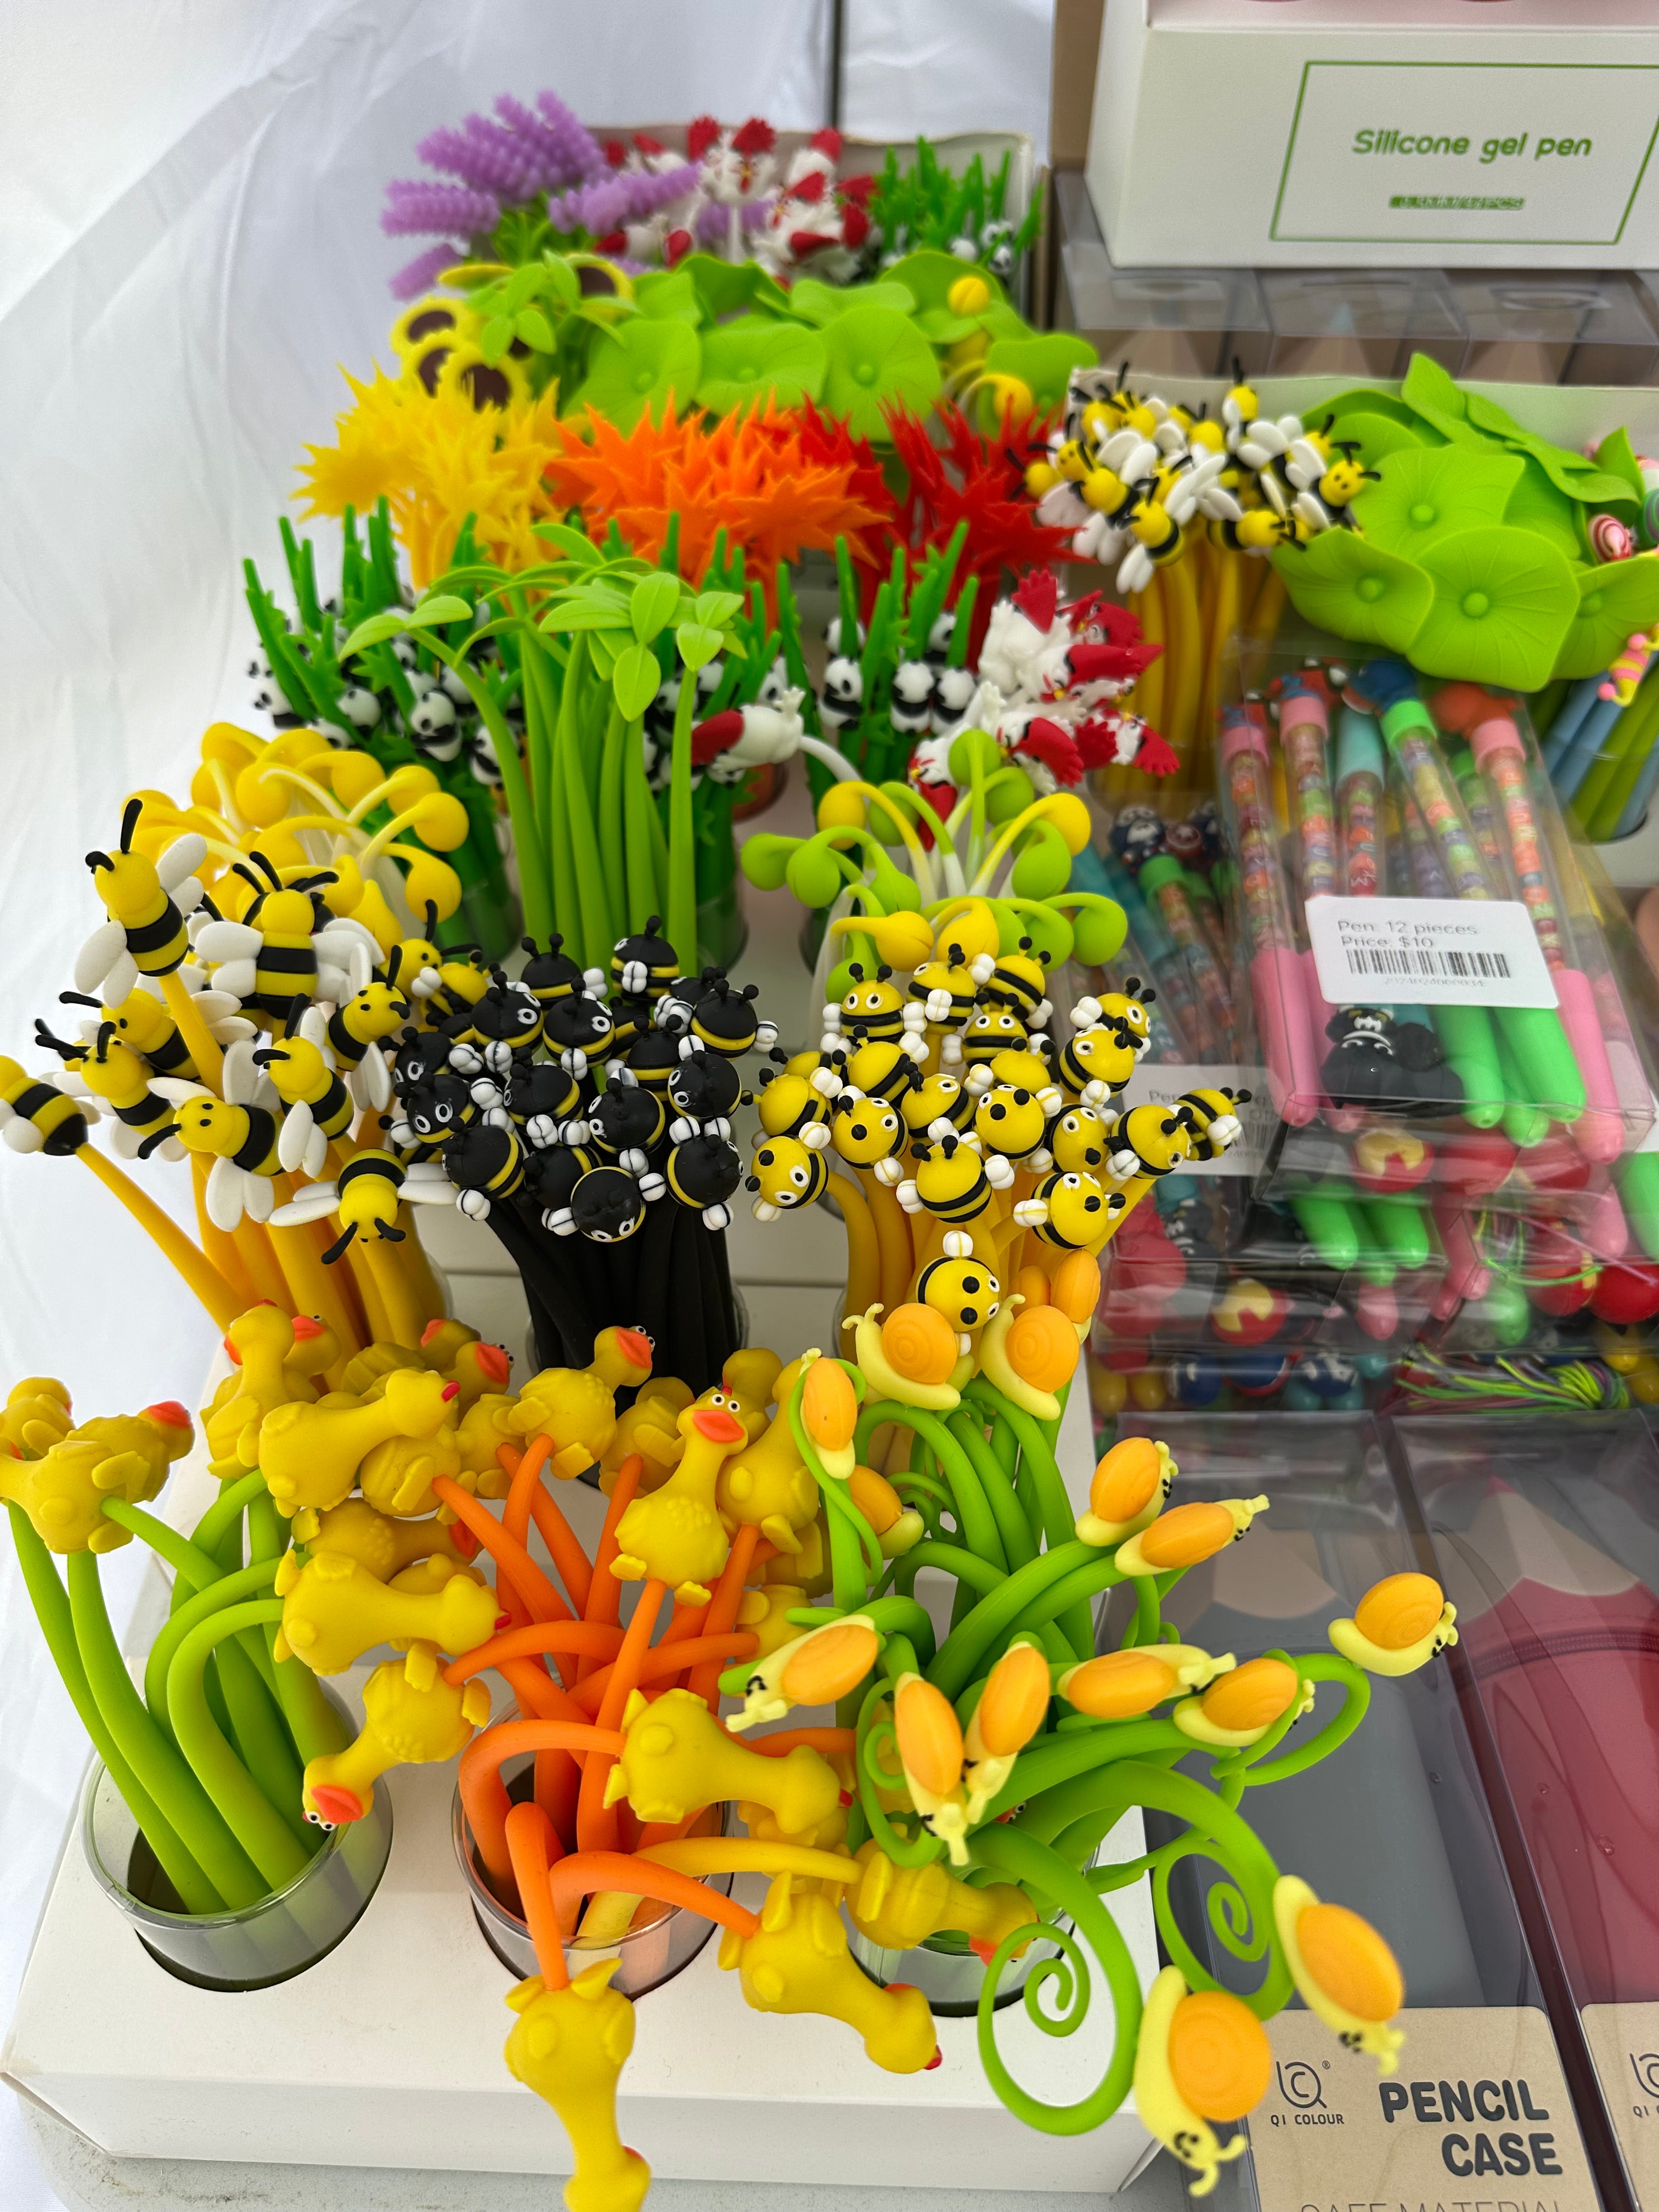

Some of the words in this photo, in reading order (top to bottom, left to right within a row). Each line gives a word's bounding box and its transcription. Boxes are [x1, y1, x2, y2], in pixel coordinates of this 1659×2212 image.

[1352, 128, 1470, 154] Silicone
[1479, 131, 1528, 164] gel
[1533, 137, 1592, 161] pen
[1386, 920, 1408, 934] 12
[1413, 922, 1477, 936] pieces
[1398, 935, 1434, 949] $10
[1379, 2079, 1550, 2123] PENCIL
[1294, 2113, 1345, 2125] COLOUR
[1441, 2132, 1563, 2177] CASE
